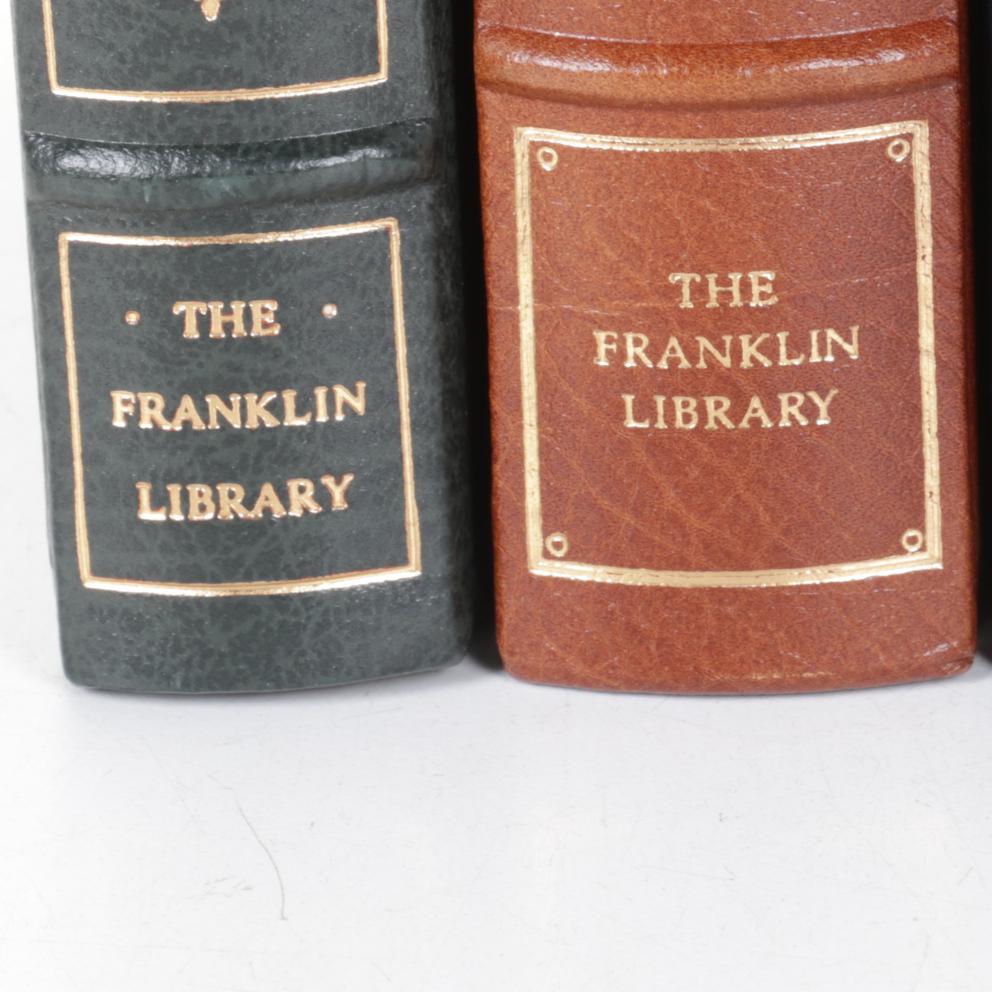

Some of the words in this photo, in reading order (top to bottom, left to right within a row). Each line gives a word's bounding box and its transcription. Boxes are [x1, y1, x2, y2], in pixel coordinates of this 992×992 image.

[668, 270, 779, 309] THE
[173, 299, 281, 340] THE
[593, 326, 860, 370] FRANKLIN
[111, 382, 367, 432] FRANKLIN
[622, 389, 839, 430] LIBRARY
[136, 474, 355, 522] LIBRARY
